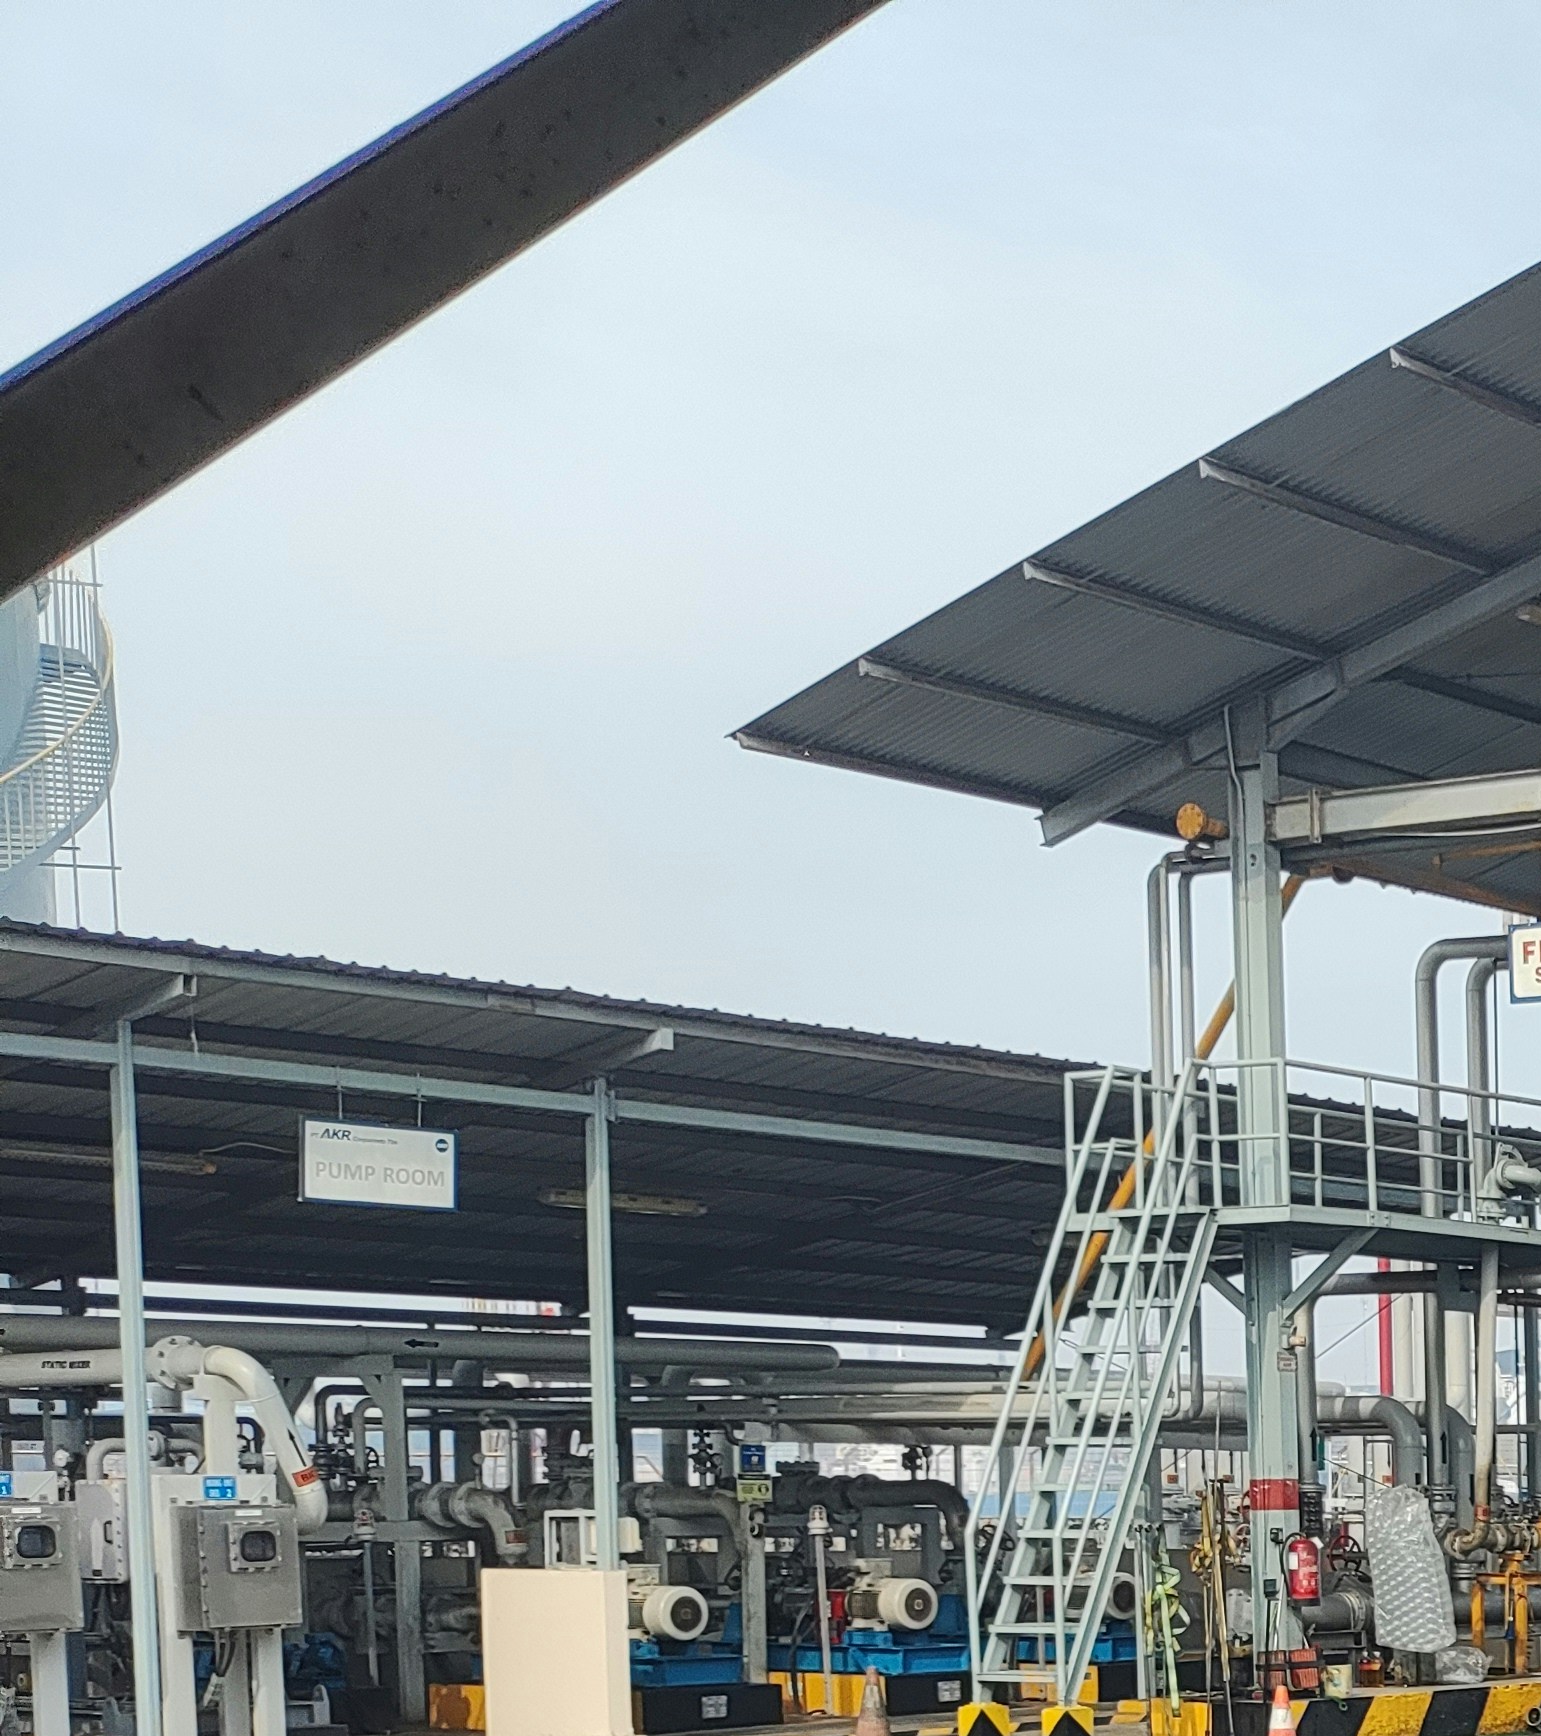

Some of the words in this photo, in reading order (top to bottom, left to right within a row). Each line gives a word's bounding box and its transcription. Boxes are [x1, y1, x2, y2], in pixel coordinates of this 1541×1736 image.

[320, 1128, 352, 1141] AKR
[315, 1161, 376, 1181] PUMP
[383, 1167, 445, 1187] ROOM
